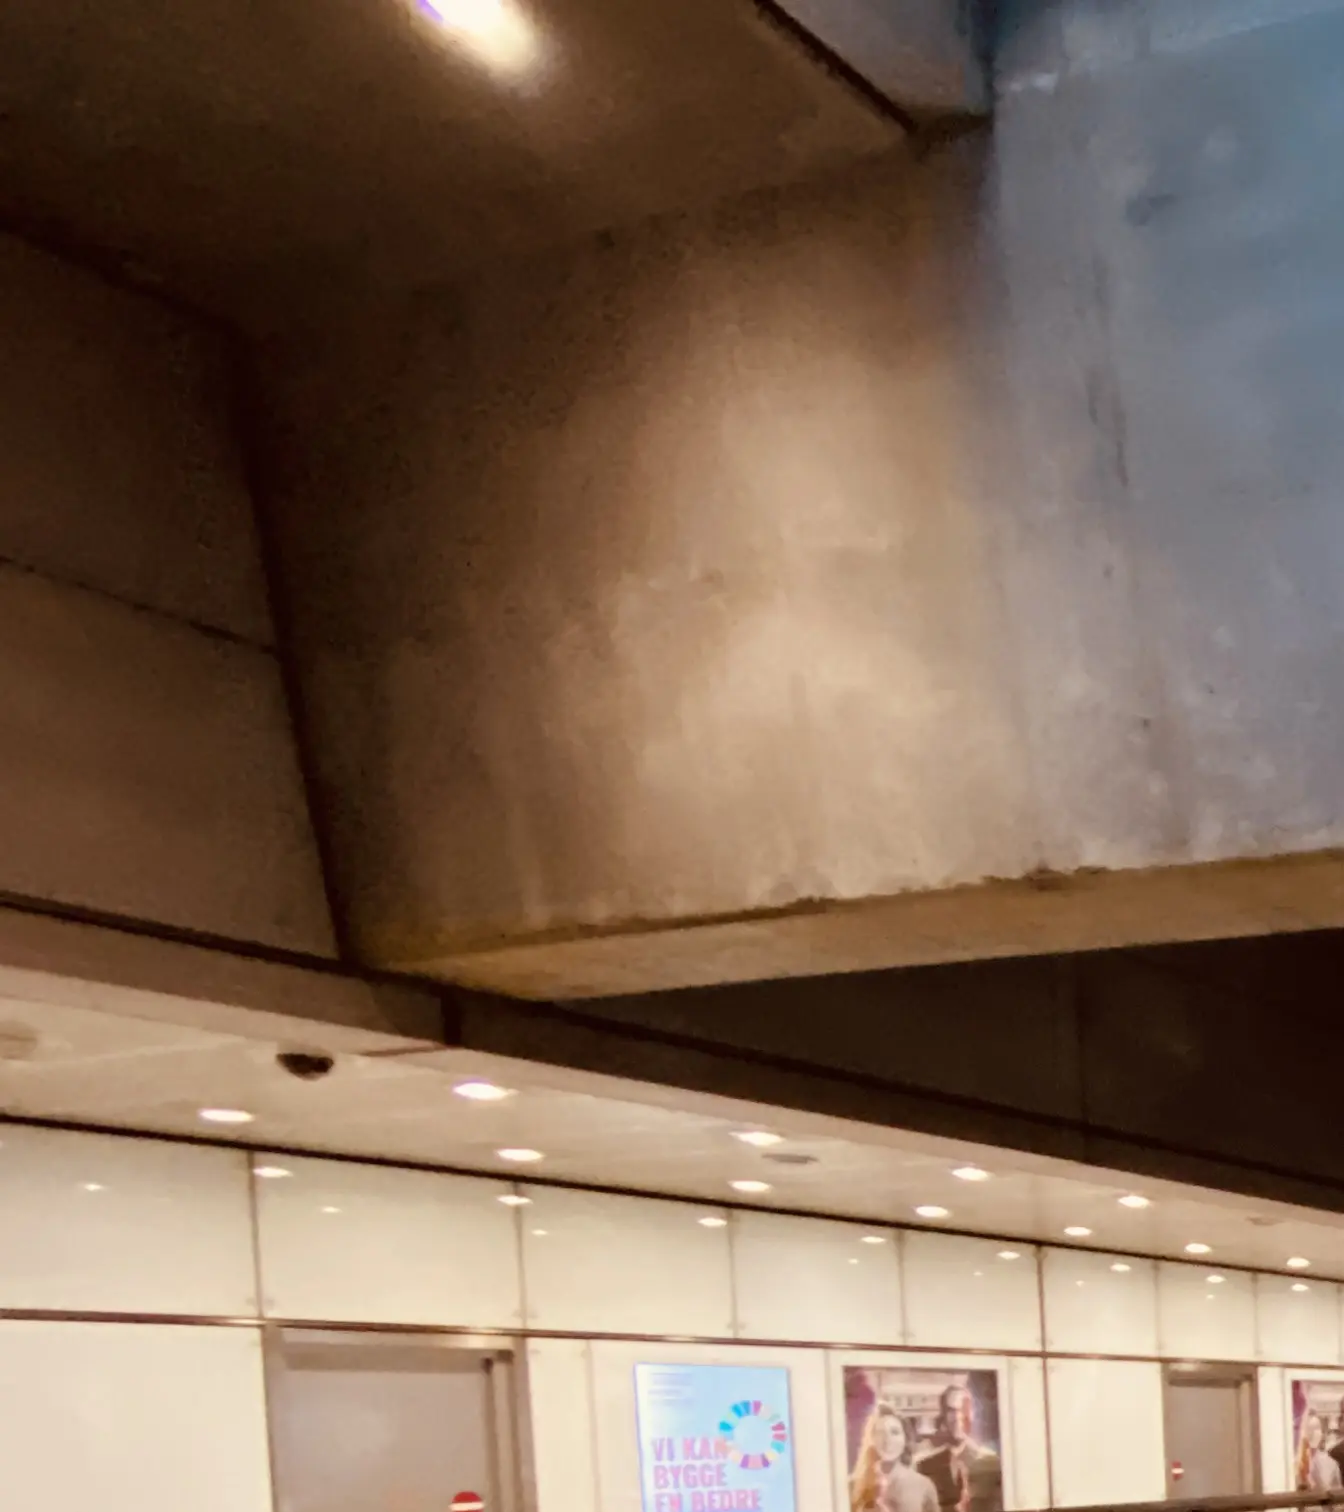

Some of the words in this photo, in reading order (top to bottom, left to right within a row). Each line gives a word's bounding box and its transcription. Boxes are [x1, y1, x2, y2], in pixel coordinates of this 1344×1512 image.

[652, 1437, 675, 1462] VI
[682, 1436, 728, 1461] KAN
[653, 1463, 728, 1489] BYGGE
